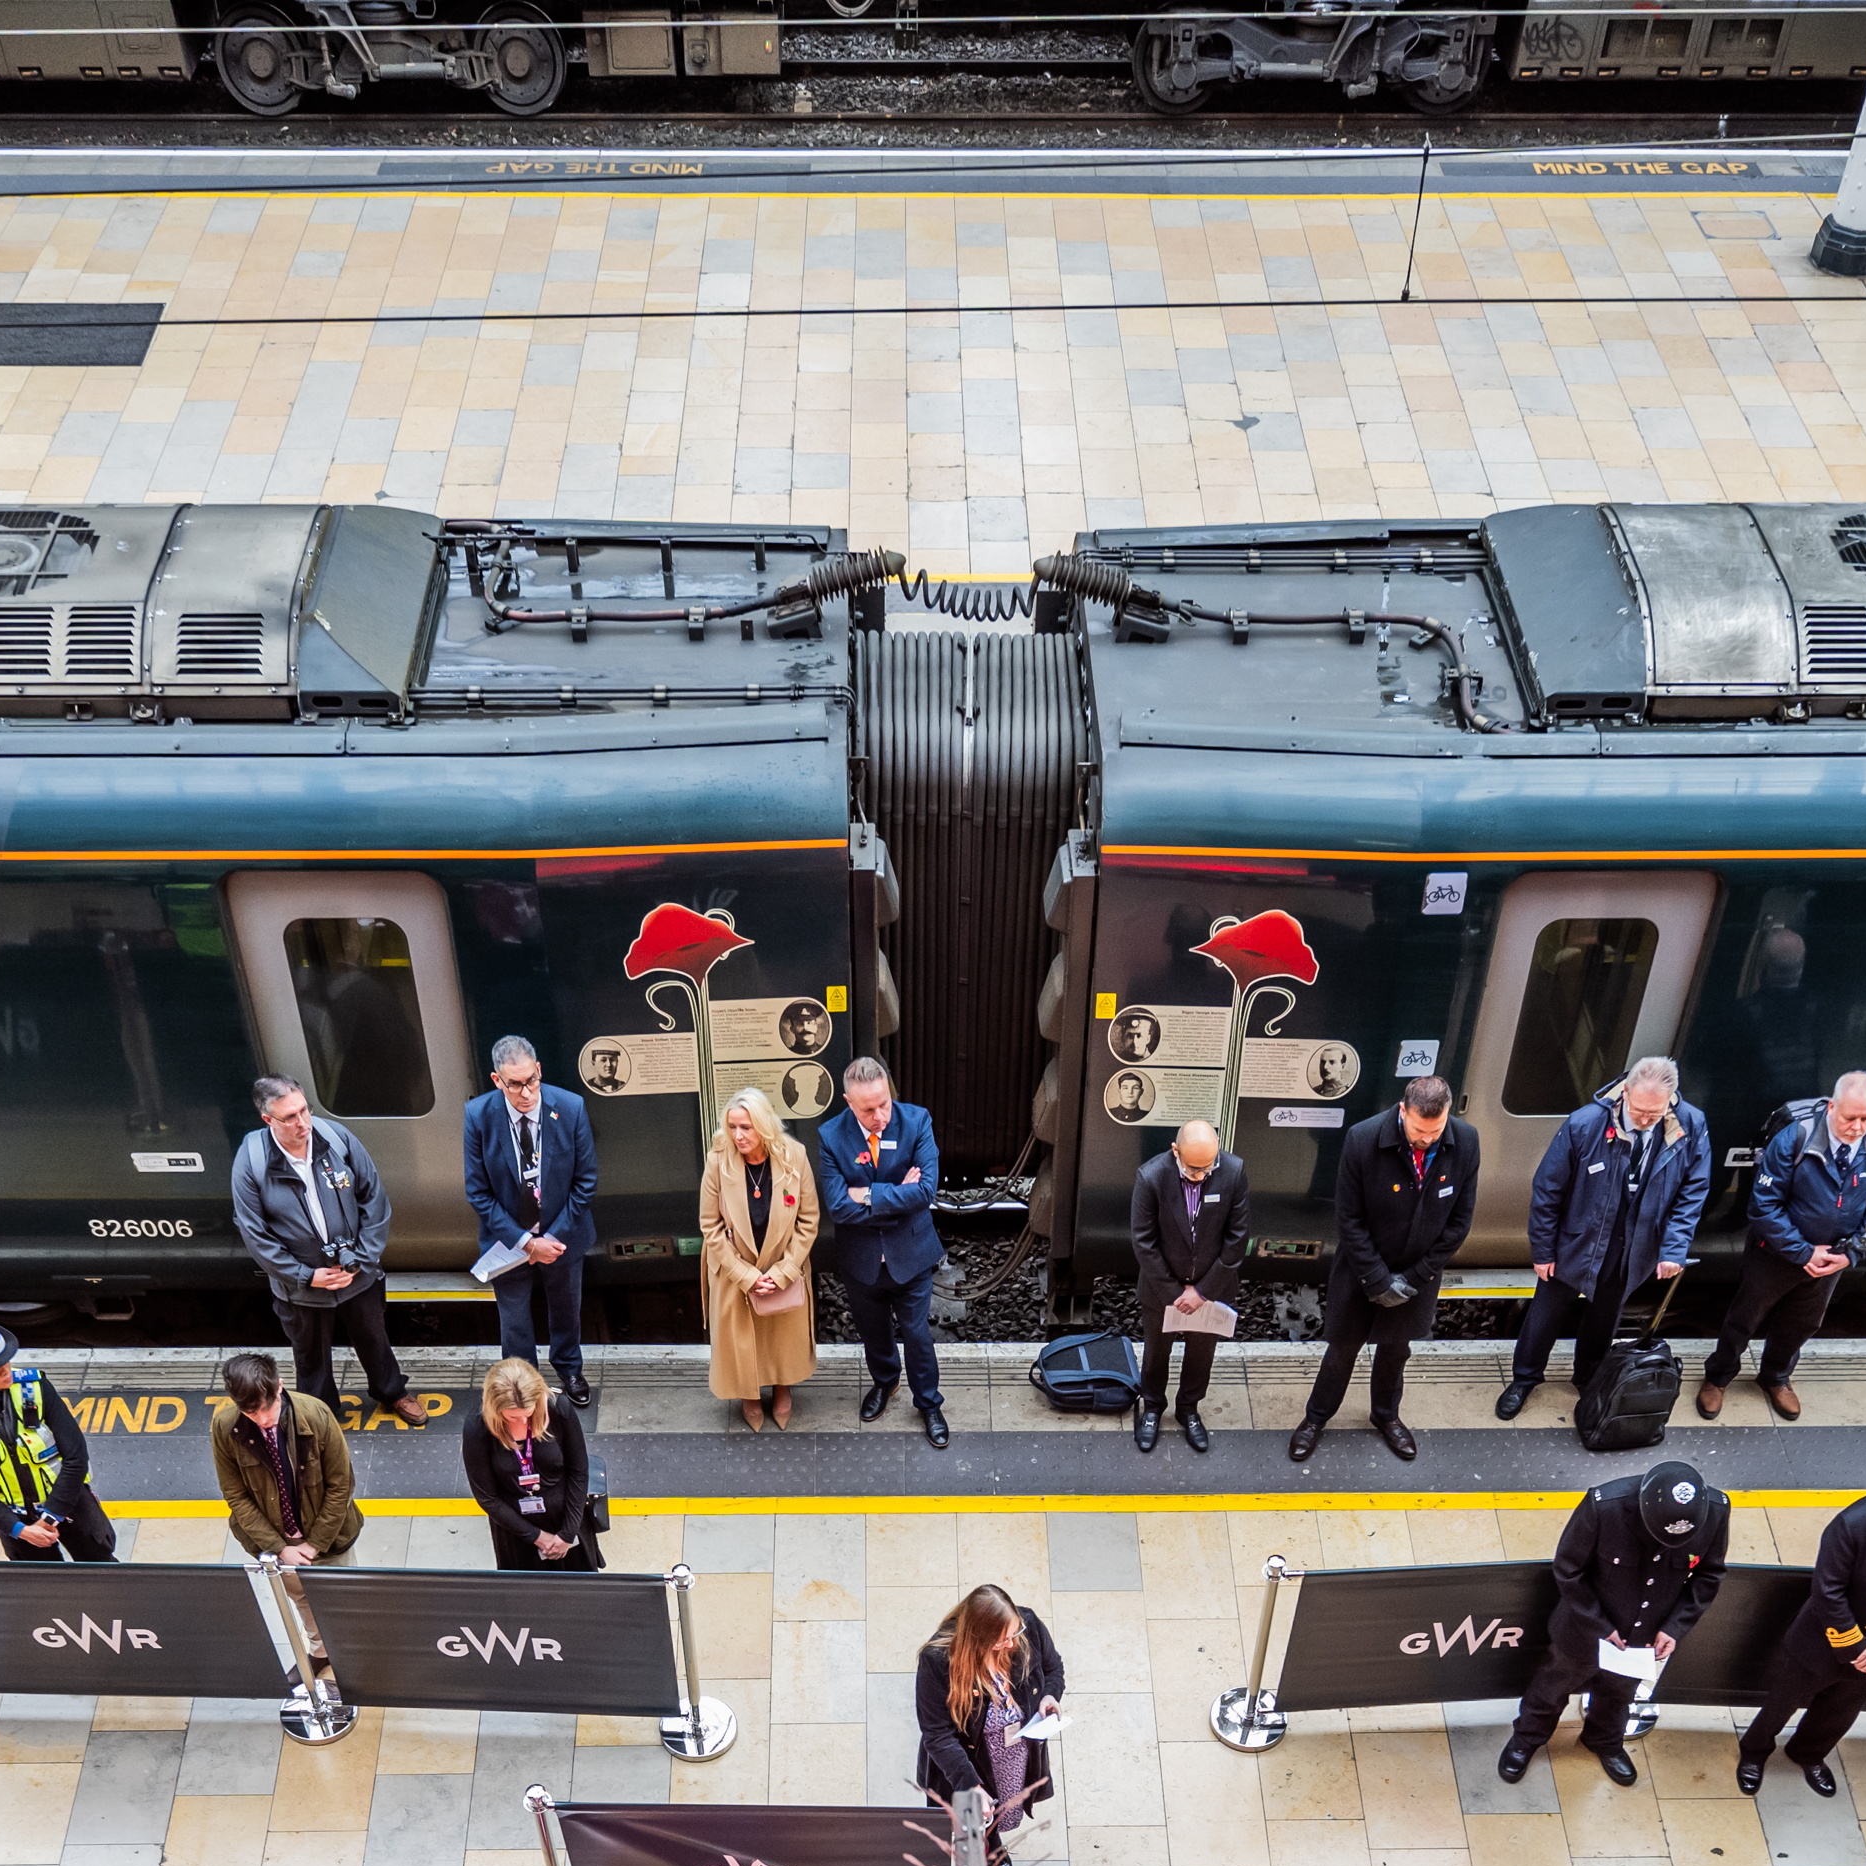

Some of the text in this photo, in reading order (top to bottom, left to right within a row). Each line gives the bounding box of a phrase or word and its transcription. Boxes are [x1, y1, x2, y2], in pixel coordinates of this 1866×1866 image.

[485, 163, 703, 175] MIND THE GAP
[1533, 162, 1749, 175] MIND THE GAP
[89, 1218, 194, 1240] 826006
[62, 1395, 187, 1434] MIND
[32, 1611, 161, 1656] GWR
[436, 1620, 563, 1667] GWR
[1399, 1615, 1524, 1660] GWR
